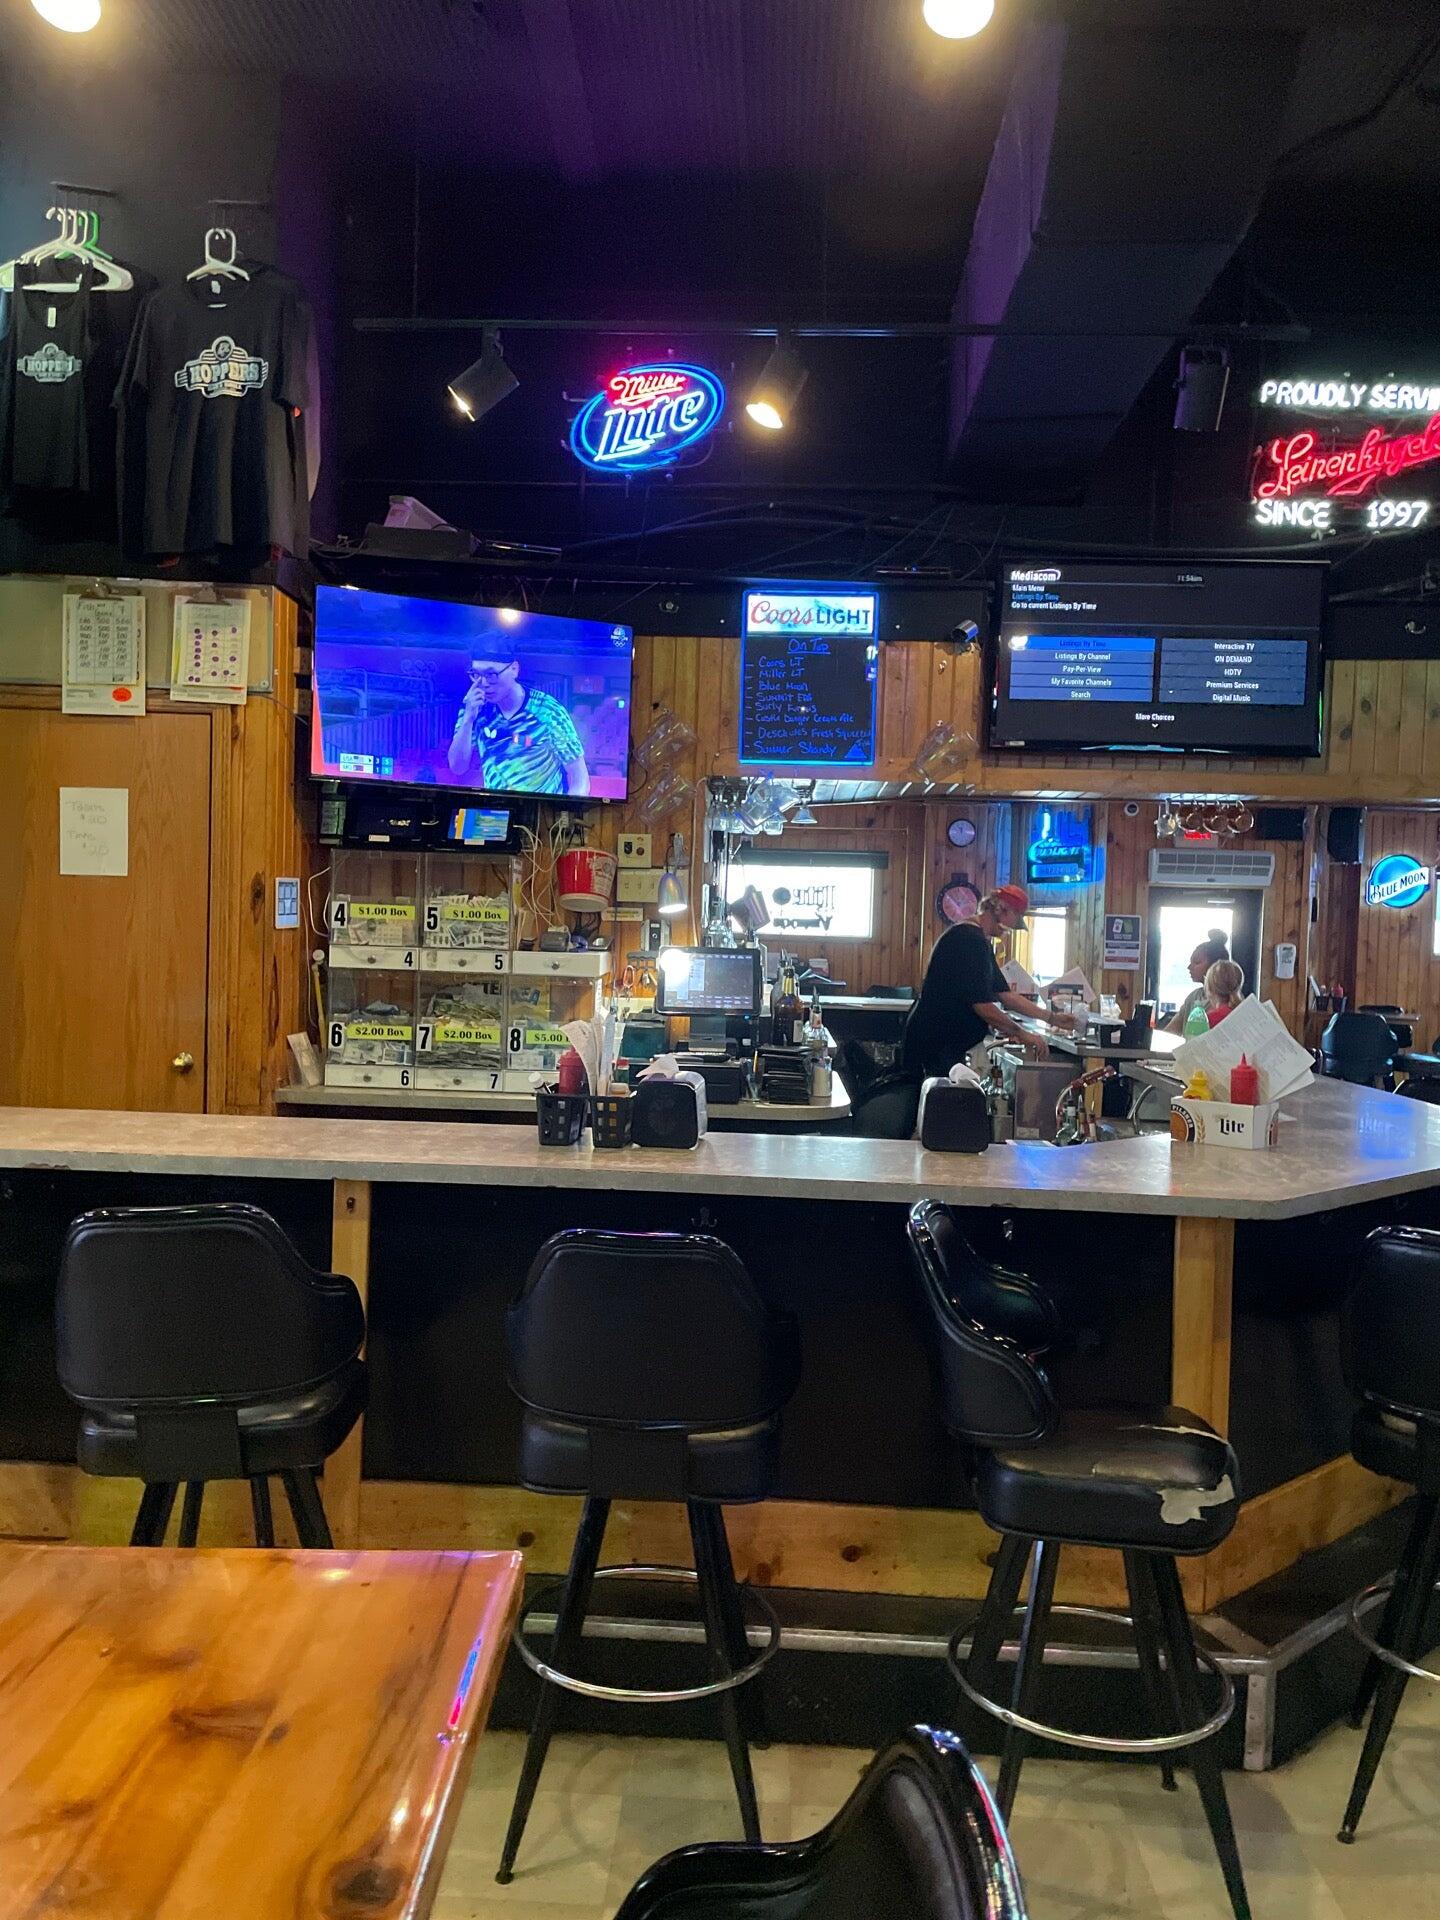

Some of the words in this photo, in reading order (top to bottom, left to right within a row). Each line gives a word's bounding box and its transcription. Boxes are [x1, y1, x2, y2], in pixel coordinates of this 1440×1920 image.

[189, 361, 260, 384] HOPPERS
[610, 373, 686, 399] Miller
[1260, 380, 1367, 407] PROUDLY
[594, 392, 705, 462] Lite
[1258, 412, 1440, 497] Leinenkugel
[1255, 499, 1332, 527] SINCE
[1366, 501, 1429, 527] 1997
[1011, 571, 1057, 581] Mediacom
[750, 600, 813, 625] Coors
[816, 609, 871, 625] LIGHT
[1049, 602, 1072, 610] Listings
[788, 638, 807, 652] On
[810, 637, 829, 652] Tap
[1246, 643, 1255, 651] TV
[1055, 653, 1078, 661] Listings
[1079, 653, 1087, 661] By
[1215, 655, 1225, 663] ON
[1226, 655, 1252, 663] DEMAND
[1224, 668, 1242, 676] HDTV
[759, 681, 780, 691] Blue
[1051, 678, 1061, 686] My
[1206, 681, 1233, 689] Premium
[1234, 681, 1259, 689] Services
[1070, 690, 1091, 698] Search
[1213, 694, 1232, 702] Digital
[1151, 713, 1175, 721] Choices
[1371, 882, 1398, 900] BLUE
[1400, 871, 1426, 889] MOON
[333, 903, 346, 926] 4
[358, 906, 387, 916] $1.00
[391, 907, 408, 917] Box
[426, 906, 438, 930] 5
[452, 911, 481, 919] $1.00
[484, 911, 502, 919] Box
[404, 951, 413, 967] 4
[494, 954, 503, 970] 5
[331, 1023, 343, 1047] 6
[355, 1027, 384, 1036] $2.00
[387, 1027, 405, 1037] Box
[419, 1026, 430, 1050] 7
[443, 1030, 472, 1039] $2.00
[475, 1031, 492, 1040] Box
[534, 1034, 563, 1042] $5.00
[510, 1028, 522, 1052] 8
[400, 1070, 410, 1086] 6
[490, 1074, 499, 1089] 7
[1220, 1118, 1245, 1135] Lite
